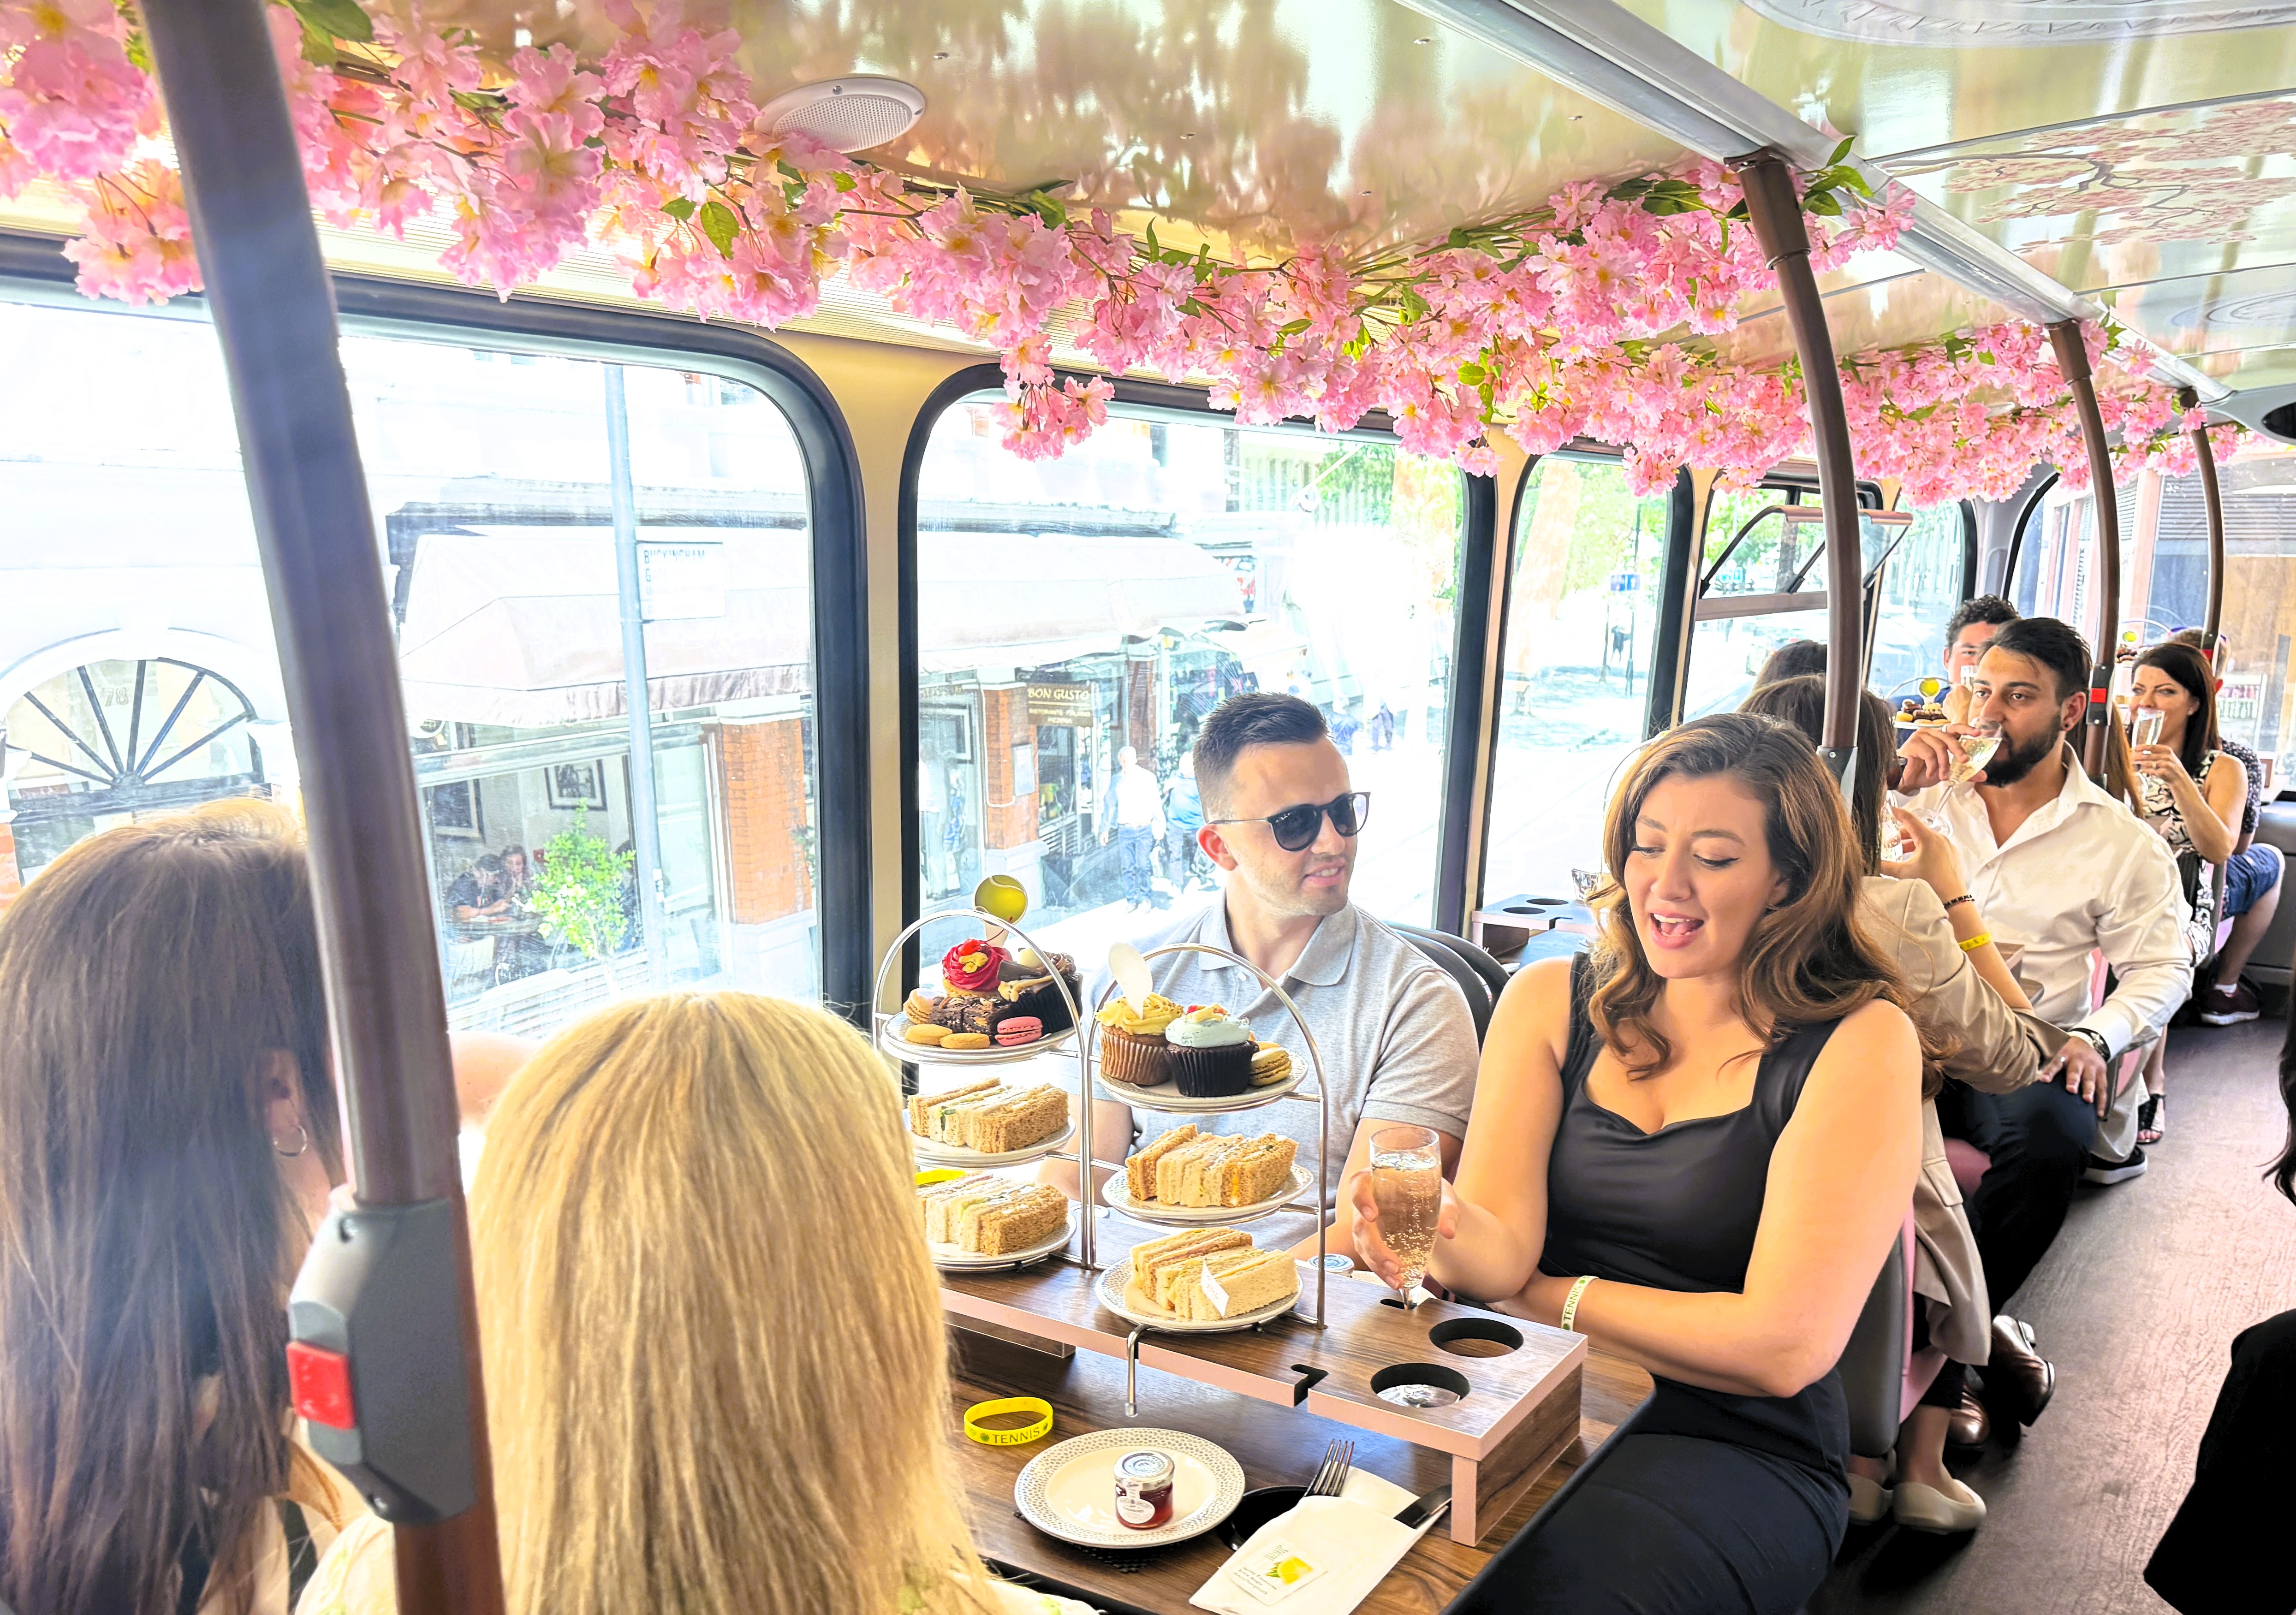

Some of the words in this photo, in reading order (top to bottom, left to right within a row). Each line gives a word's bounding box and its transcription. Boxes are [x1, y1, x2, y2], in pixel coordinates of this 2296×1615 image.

[101, 687, 129, 707] 78
[1027, 687, 1052, 699] BON
[1053, 689, 1090, 701] GUSTO
[1563, 1286, 1582, 1321] TENNIS
[992, 1427, 1040, 1444] TENNIS
